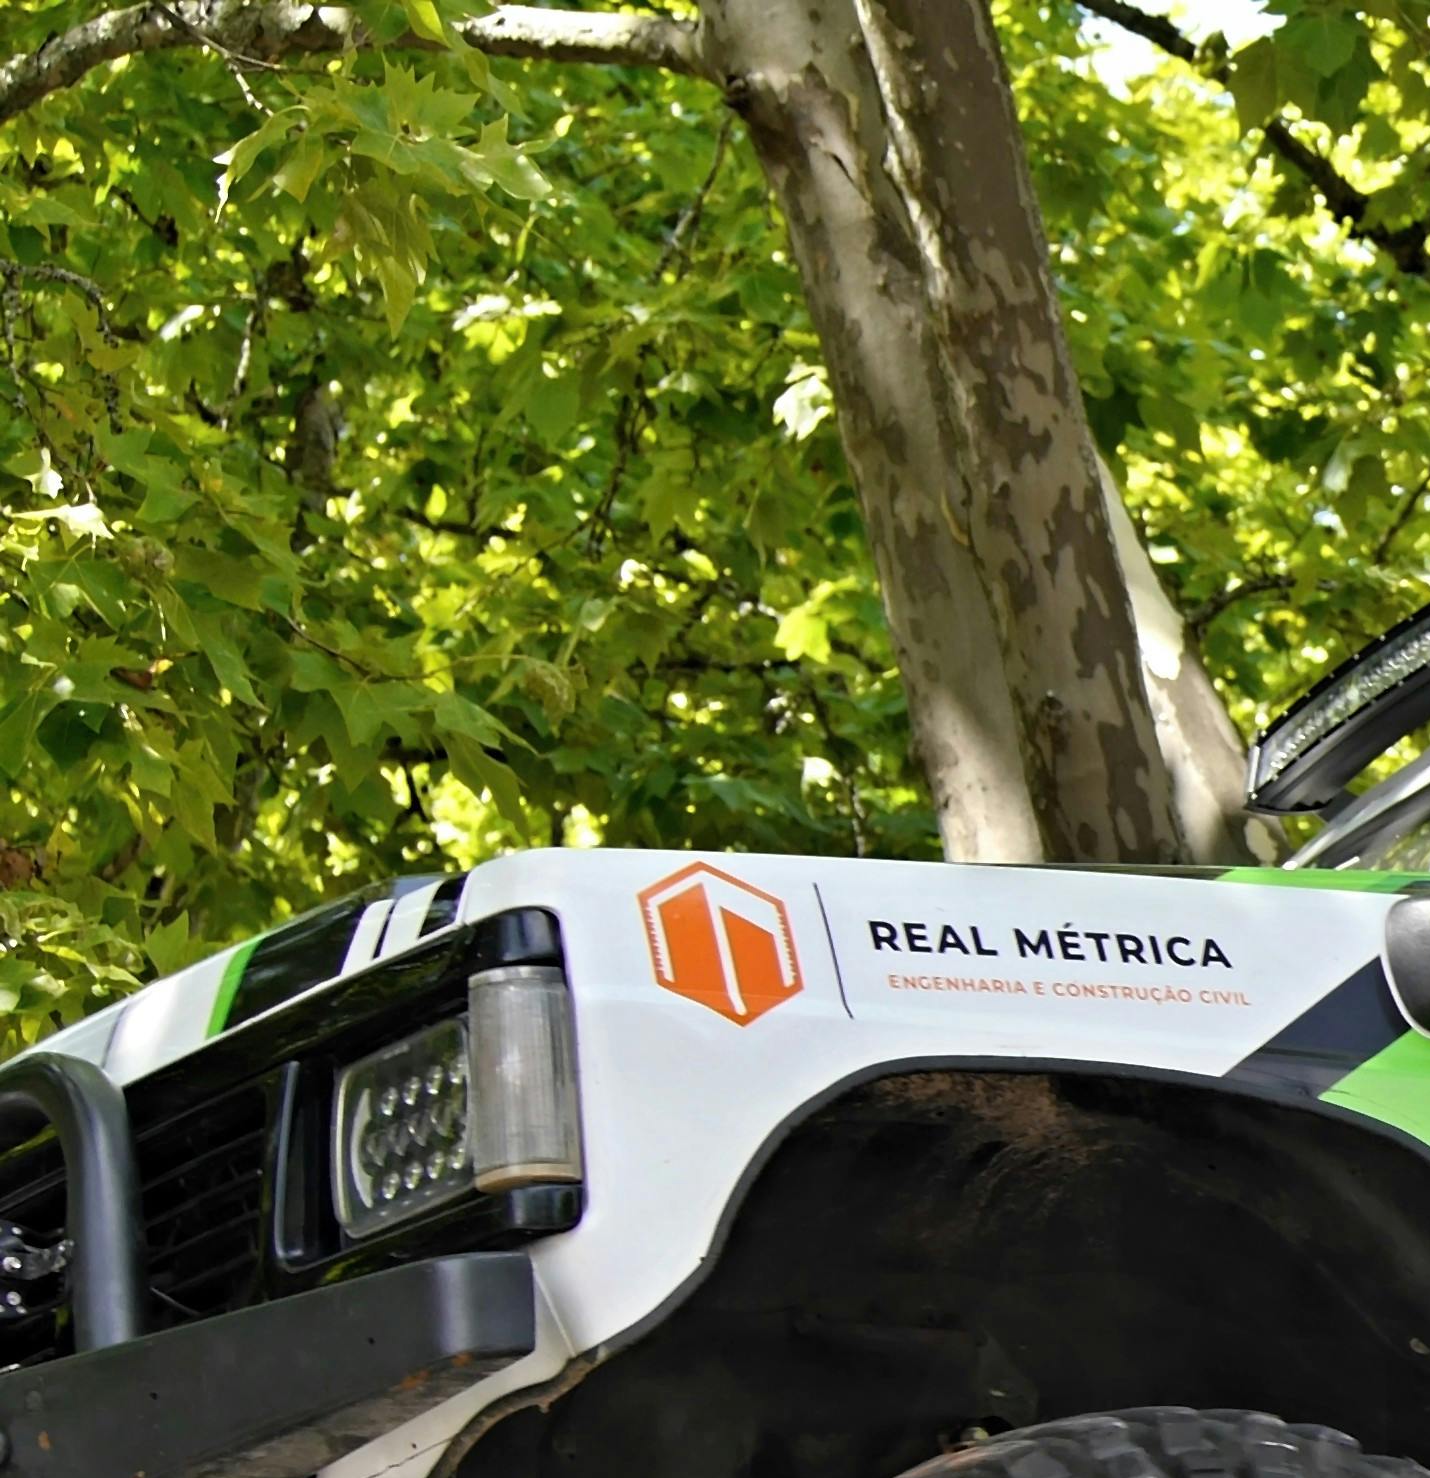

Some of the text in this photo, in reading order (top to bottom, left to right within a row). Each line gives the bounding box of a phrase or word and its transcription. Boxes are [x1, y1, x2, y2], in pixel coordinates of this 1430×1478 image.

[868, 919, 1233, 969] REAL MÉTRICA
[887, 973, 1251, 1007] ENGENHARIA E CONSTRUÇÃO CIVIL
